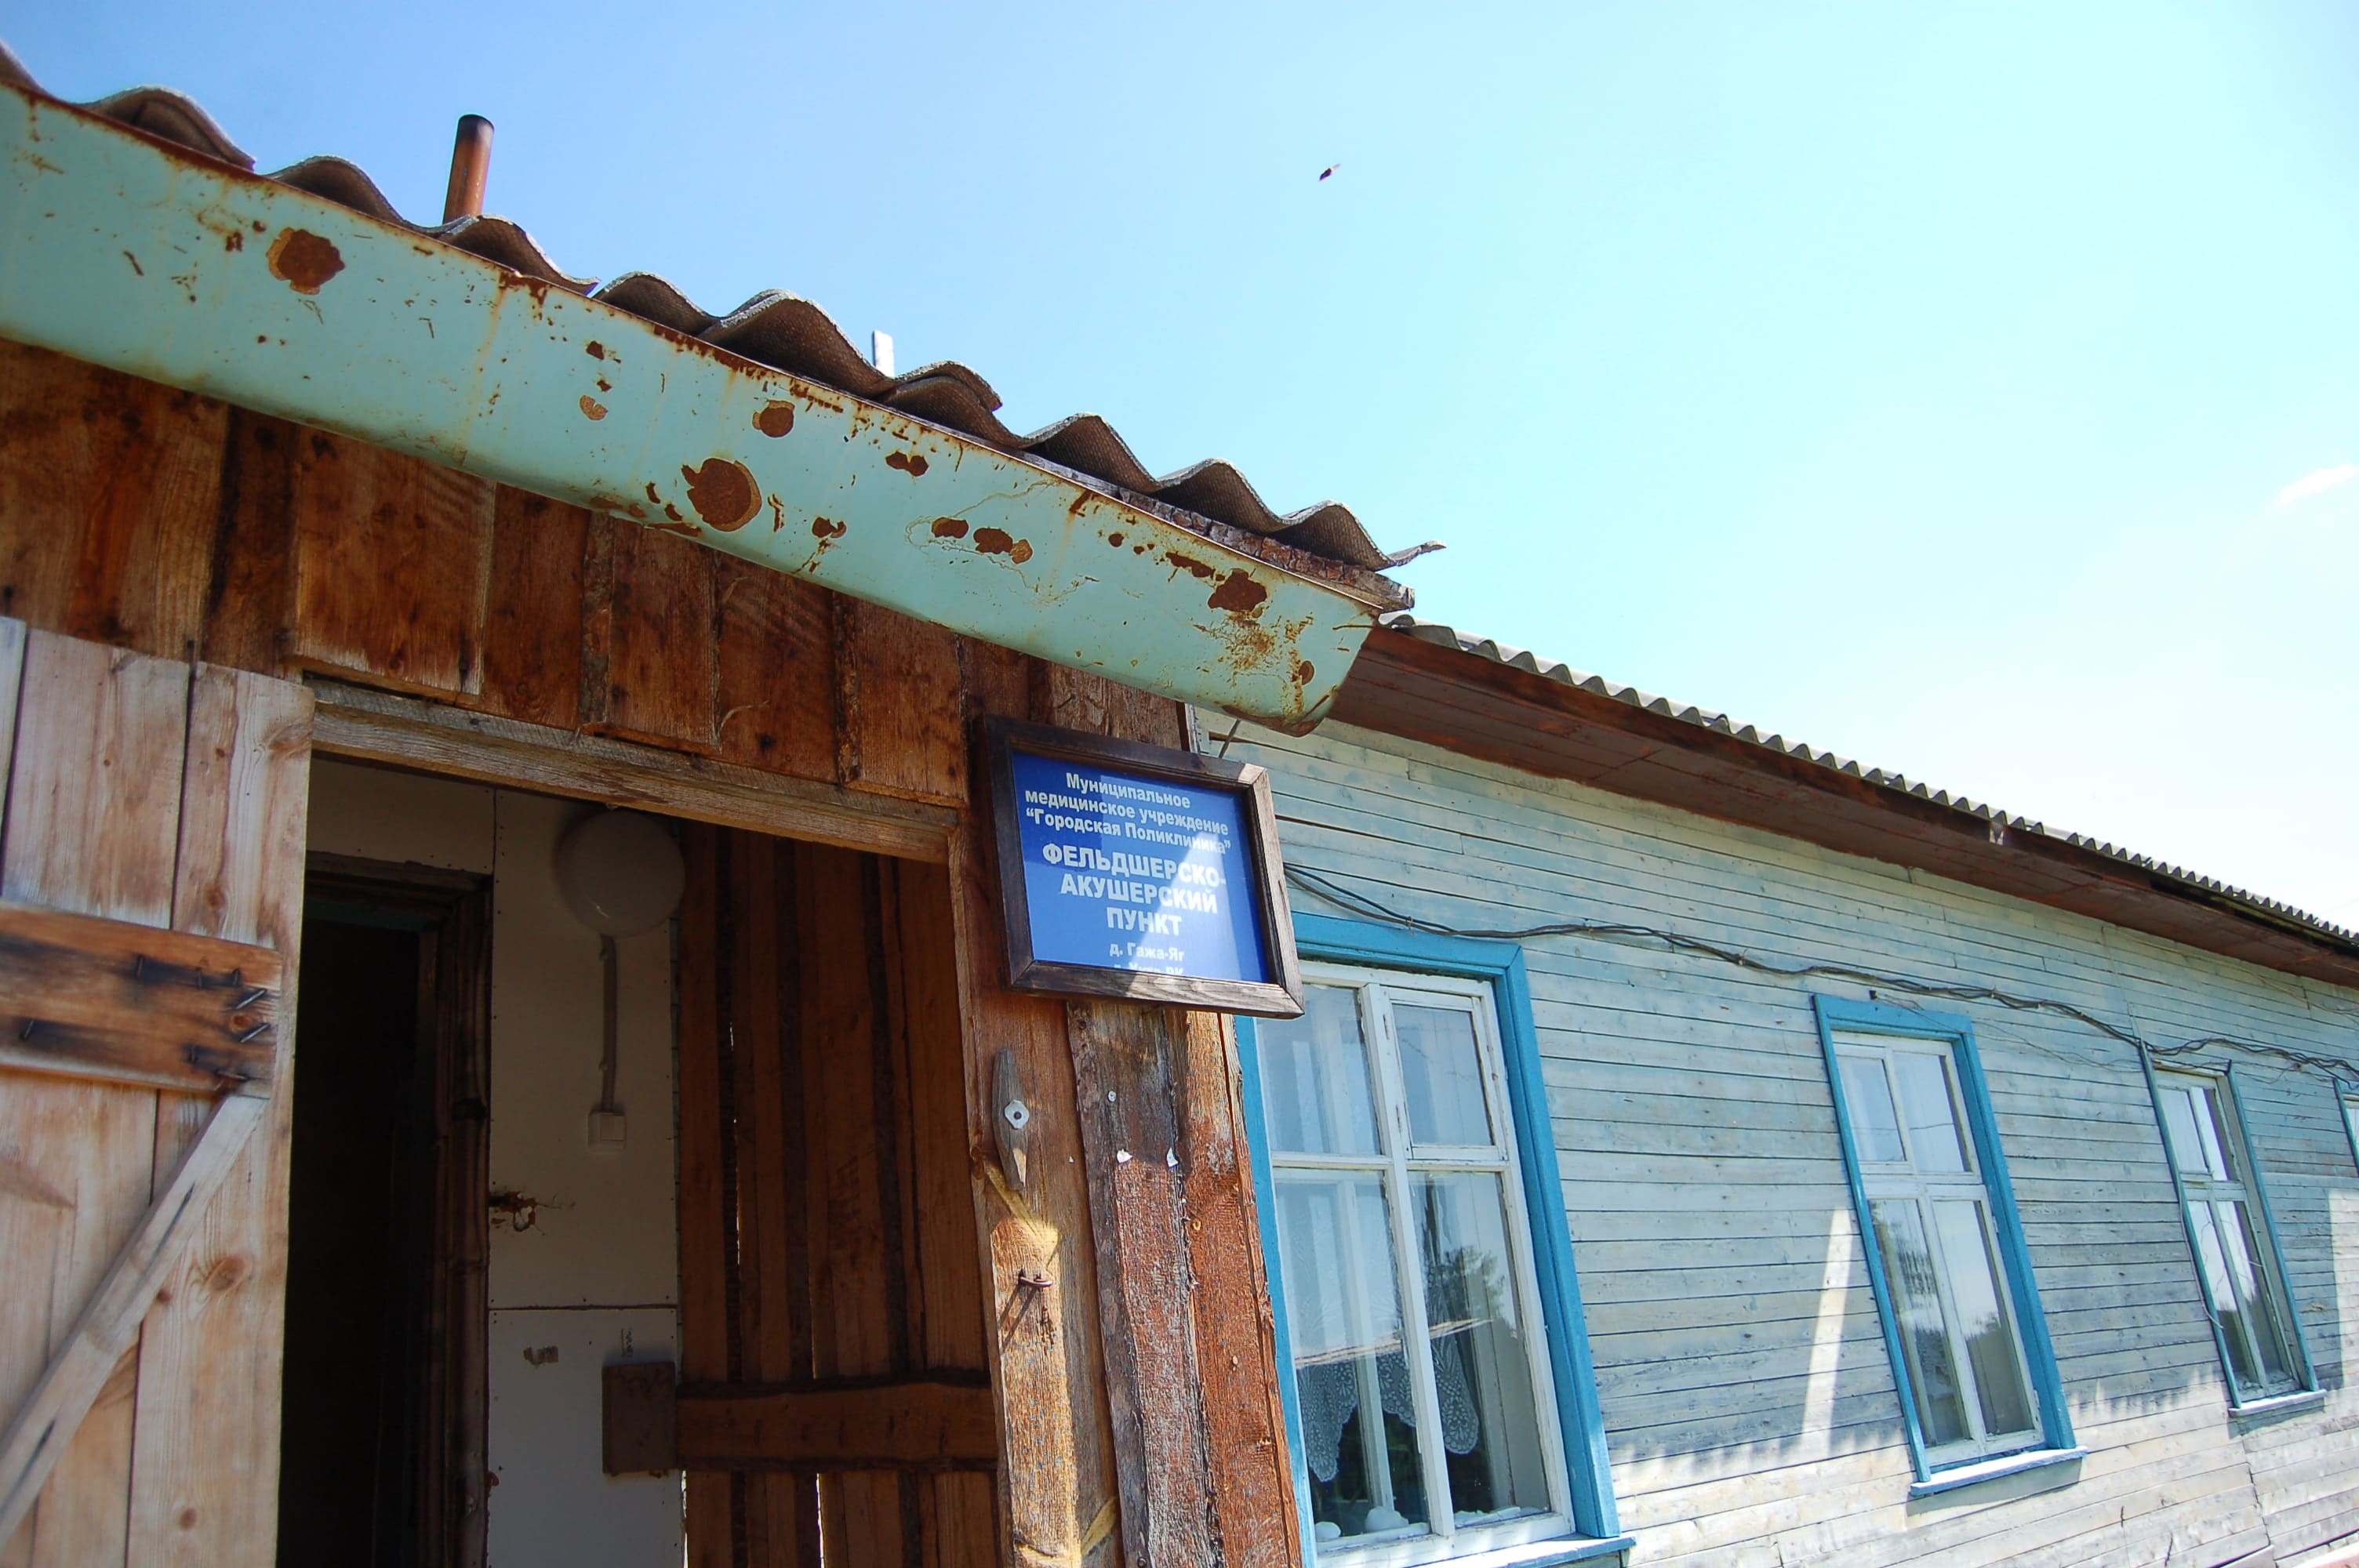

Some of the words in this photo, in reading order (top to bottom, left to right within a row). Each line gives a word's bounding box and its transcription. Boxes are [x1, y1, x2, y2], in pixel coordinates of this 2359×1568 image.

[1066, 772, 1190, 808] Муниципальное
[1025, 790, 1136, 818] медицинское
[1139, 808, 1229, 836] учреждение
[1042, 843, 1226, 887] ФЕЛЬДШЕРСКО-
[1060, 873, 1218, 914] АКУШЕРСКИЙ
[1107, 906, 1183, 936] ПУНКТ
[1110, 942, 1124, 957] д.
[1127, 942, 1184, 962] Гажа-Яг
